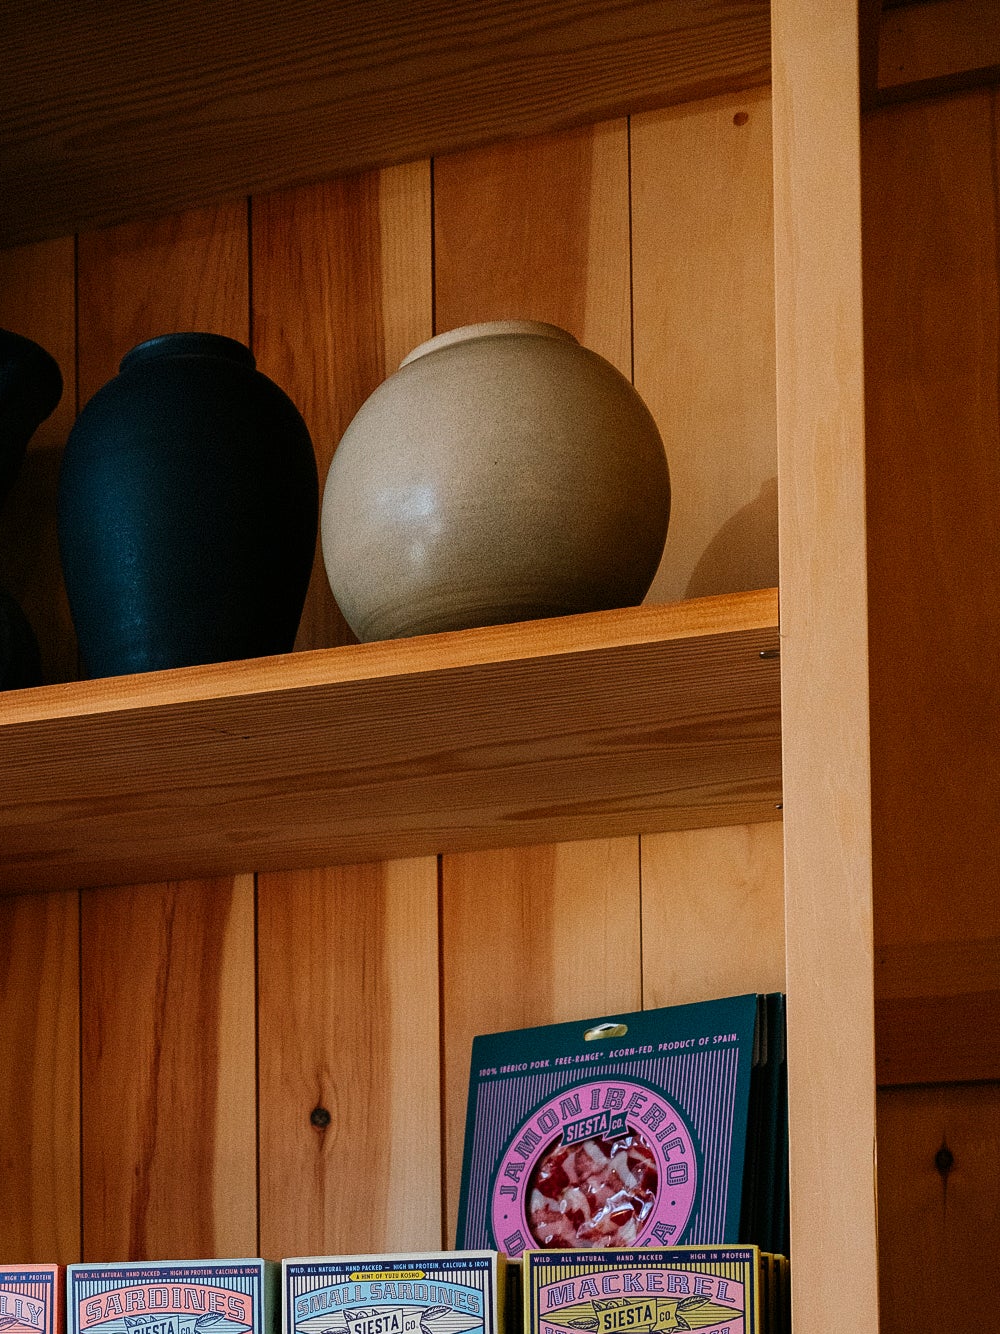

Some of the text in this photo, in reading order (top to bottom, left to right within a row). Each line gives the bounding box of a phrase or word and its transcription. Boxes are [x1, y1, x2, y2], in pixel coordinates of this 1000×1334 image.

[658, 1039, 695, 1051] PRODUCT
[699, 1036, 709, 1046] OF
[713, 1034, 740, 1044] SPAIN.
[566, 1114, 623, 1142] SIESTA CO.
[86, 1287, 245, 1323] SARDINES
[297, 1283, 480, 1318] SMALL SARDINES
[547, 1272, 735, 1308] MACKEREL
[604, 1306, 652, 1330] SIESTA
